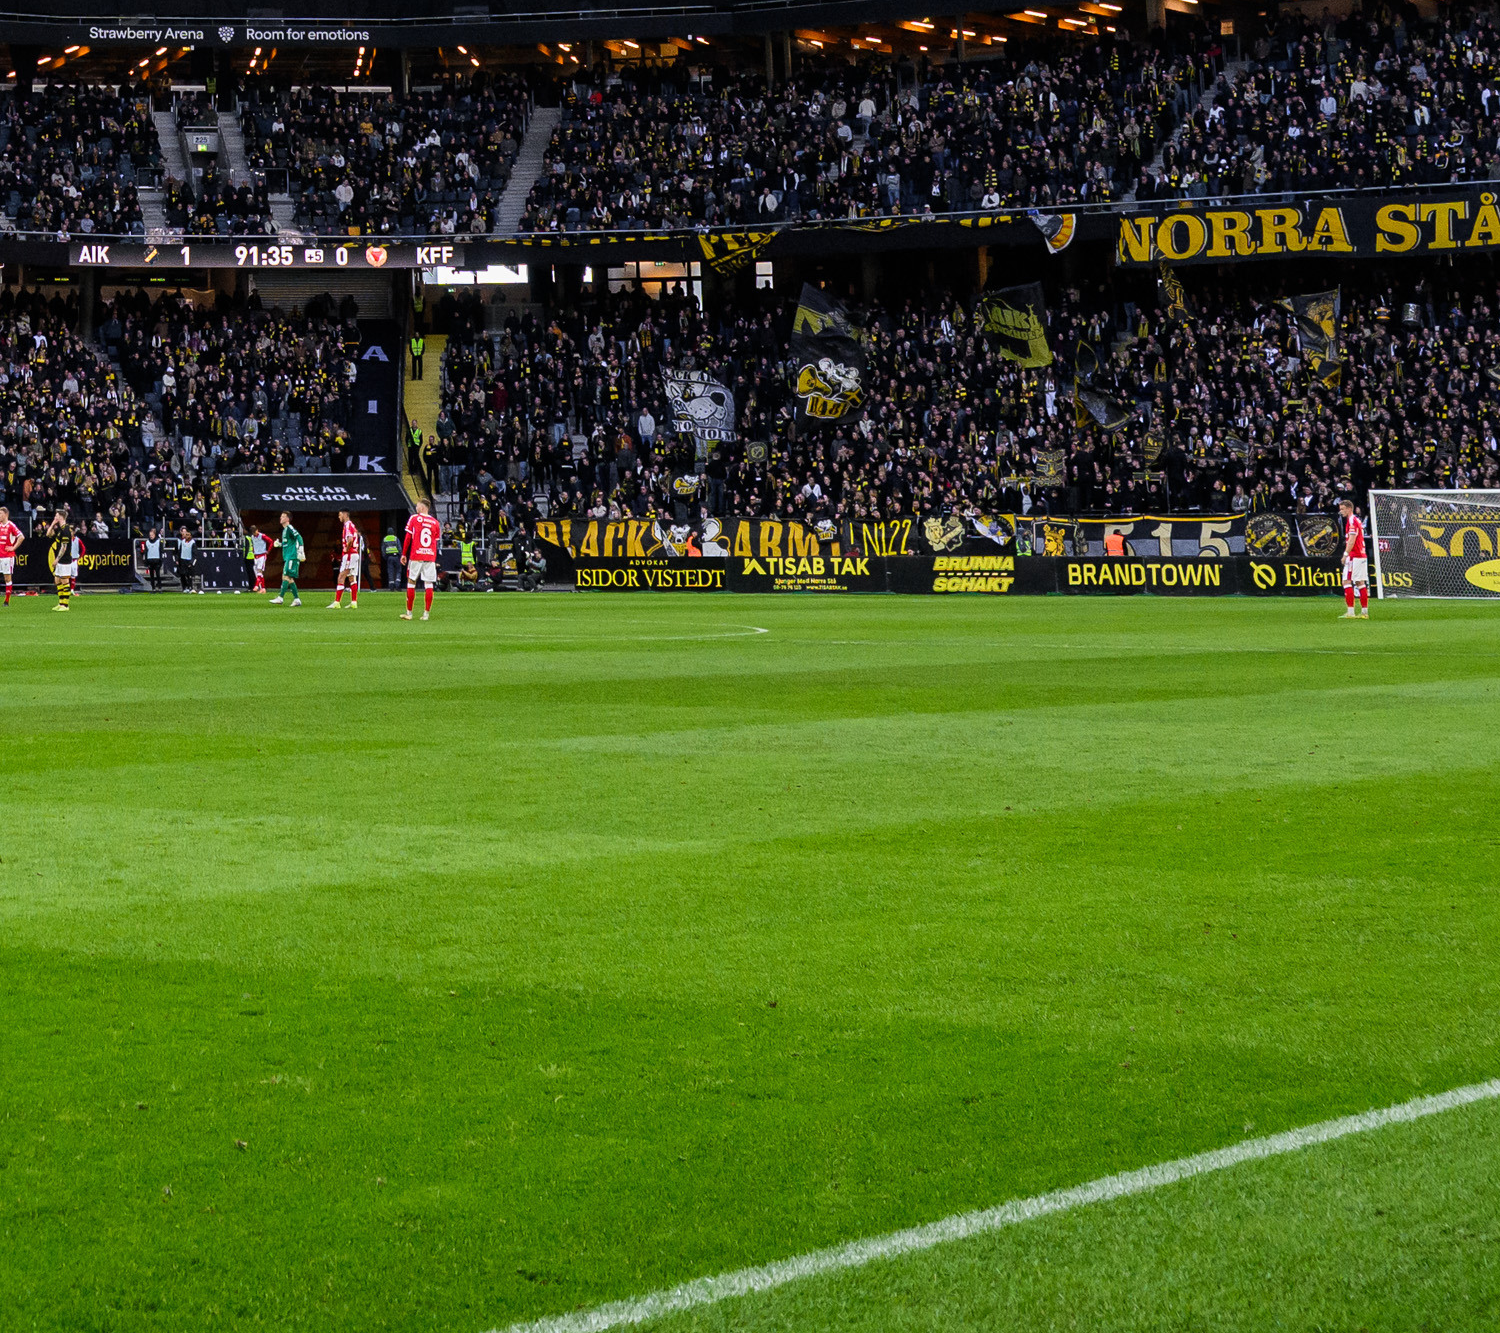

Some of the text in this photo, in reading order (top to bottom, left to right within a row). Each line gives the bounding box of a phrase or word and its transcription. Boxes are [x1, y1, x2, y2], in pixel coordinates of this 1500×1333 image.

[89, 26, 205, 42] Strawberry Arena
[246, 28, 370, 42] Room for emotions
[1118, 207, 1357, 263] NORRA
[79, 245, 192, 265] AIK 1
[235, 245, 324, 266] 91:35 +5
[336, 245, 455, 266] 0 KFF
[262, 494, 377, 502] STOCKHOLM.
[285, 483, 348, 495] AIK ÄR
[420, 527, 432, 548] 6
[75, 549, 132, 571] asypartner
[629, 559, 671, 567] ADVOKAT
[766, 557, 870, 576] TISAB TAK
[932, 556, 1015, 571] BRUNNA
[576, 568, 727, 588] ISIDOR VISTEDT
[932, 577, 1015, 592] SCHAKT
[1068, 563, 1223, 587] BRANDTOWN
[1284, 563, 1344, 588] Elléni
